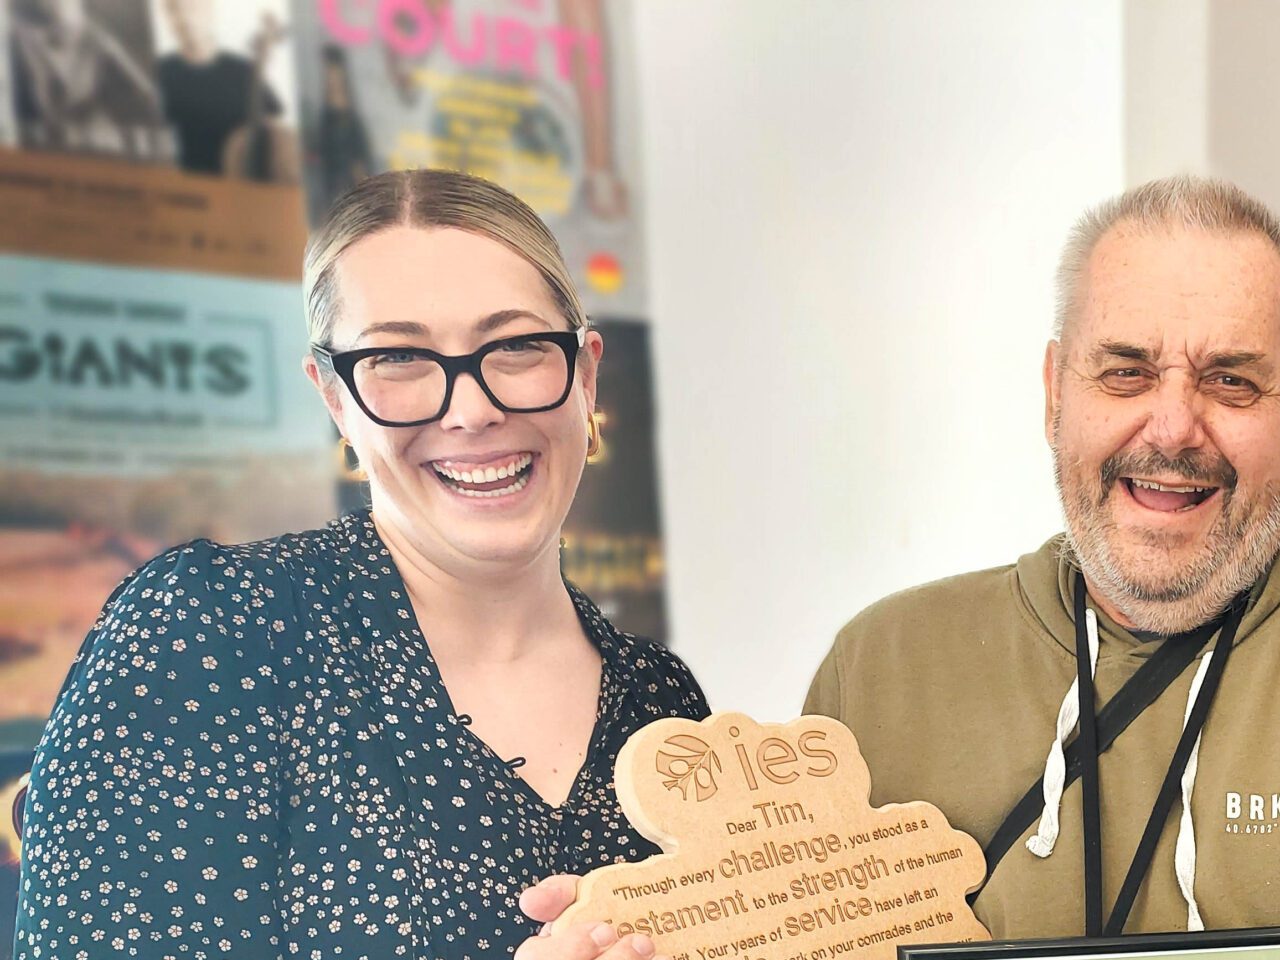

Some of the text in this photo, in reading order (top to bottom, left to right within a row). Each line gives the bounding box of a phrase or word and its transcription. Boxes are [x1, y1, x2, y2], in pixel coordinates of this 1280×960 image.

[729, 726, 838, 791] ies
[726, 801, 814, 835] Dear Tim,
[603, 847, 963, 938] estament to the strength of the human
[613, 819, 929, 900] "Through every challenge, you stood as a
[697, 944, 728, 960] Your
[731, 934, 767, 955] years
[769, 927, 783, 941] of
[785, 897, 873, 936] service
[875, 897, 903, 913] have
[904, 890, 921, 905] left
[924, 887, 939, 899] an
[811, 947, 827, 960] on
[828, 940, 854, 958] your
[858, 925, 912, 947] comrades
[914, 915, 935, 930] and
[935, 911, 954, 922] the
